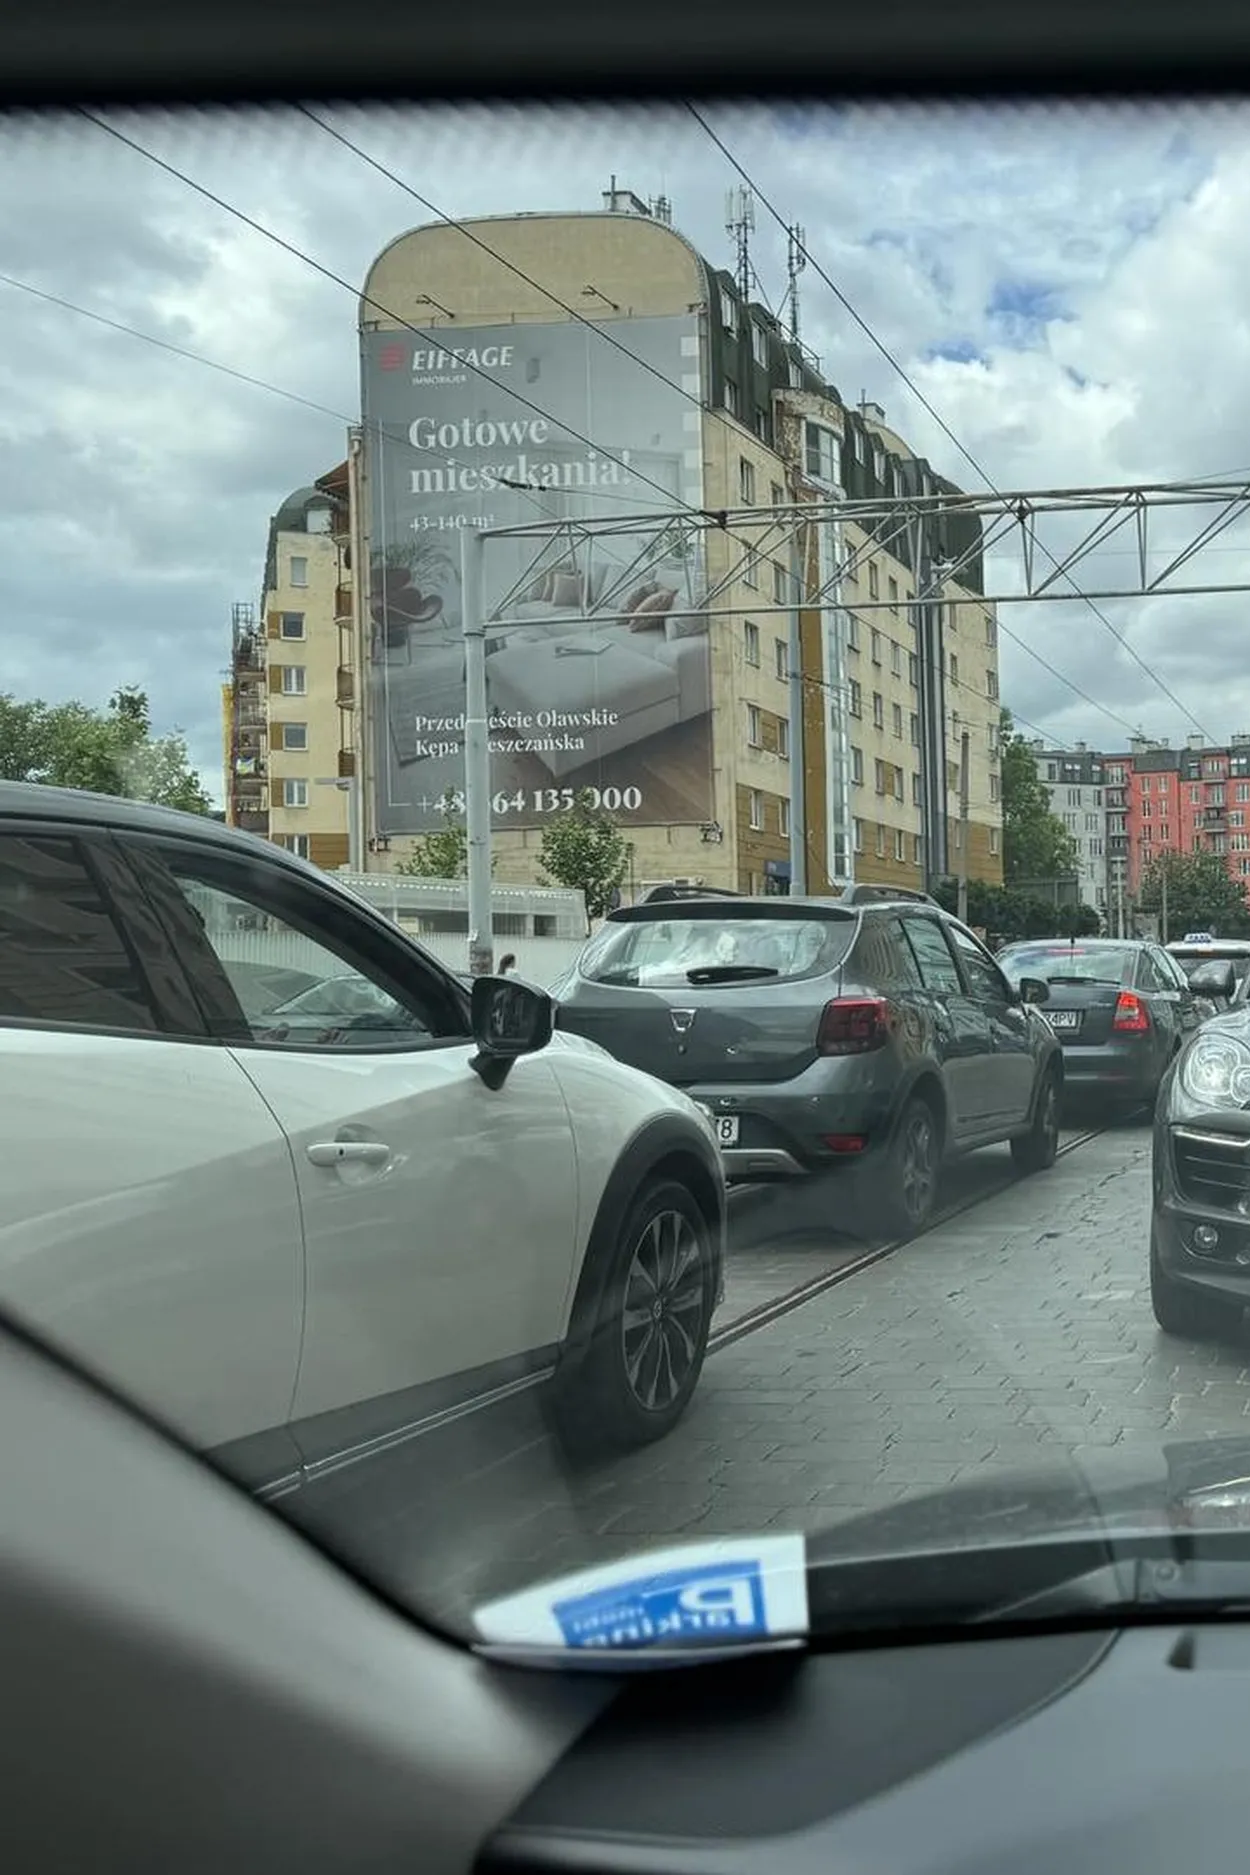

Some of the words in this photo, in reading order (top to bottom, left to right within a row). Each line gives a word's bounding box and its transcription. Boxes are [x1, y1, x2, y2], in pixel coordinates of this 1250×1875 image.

[412, 346, 514, 371] EIFFAGE
[408, 416, 549, 449] Gotowe
[409, 451, 633, 493] mieszkania!
[415, 711, 532, 731] Przedeście
[416, 738, 460, 759] Kępa
[487, 733, 585, 753] eszczańska
[489, 788, 526, 814] 64
[533, 788, 574, 812] 135
